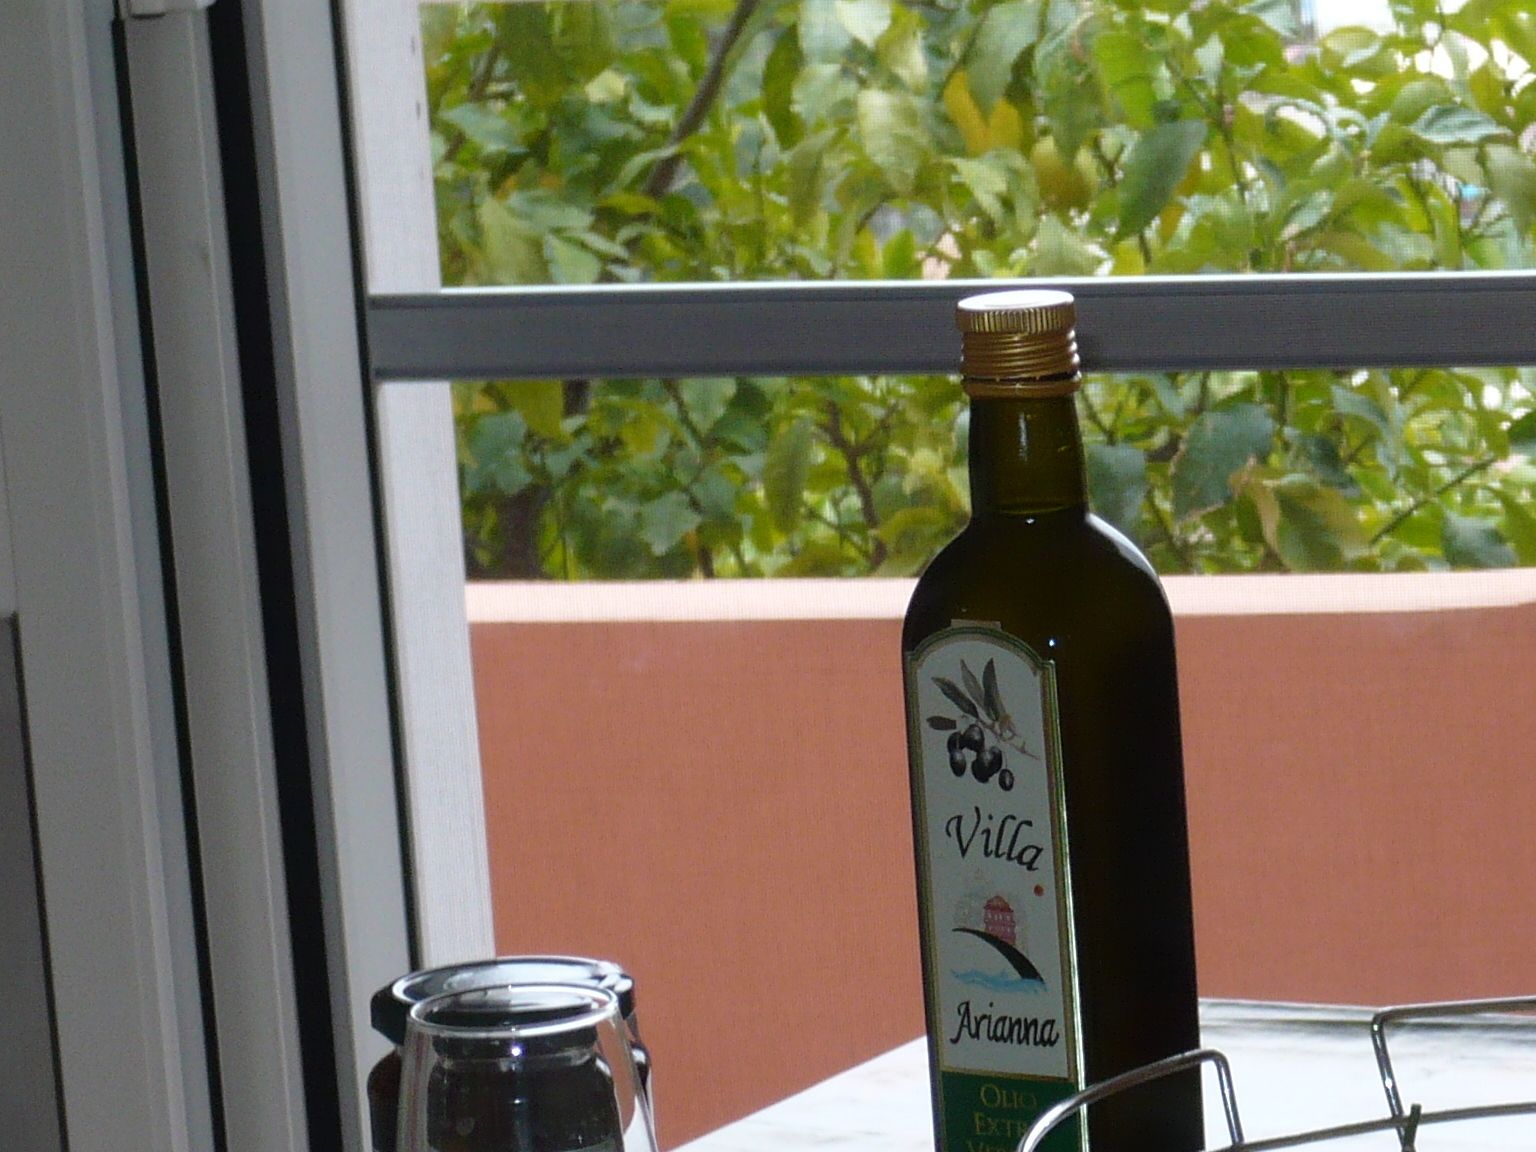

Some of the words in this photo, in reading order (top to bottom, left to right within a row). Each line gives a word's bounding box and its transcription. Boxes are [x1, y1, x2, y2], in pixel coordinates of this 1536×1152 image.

[945, 805, 1044, 872] Villa
[950, 1001, 1060, 1048] Arianna
[974, 1112, 1029, 1138] EXTR
